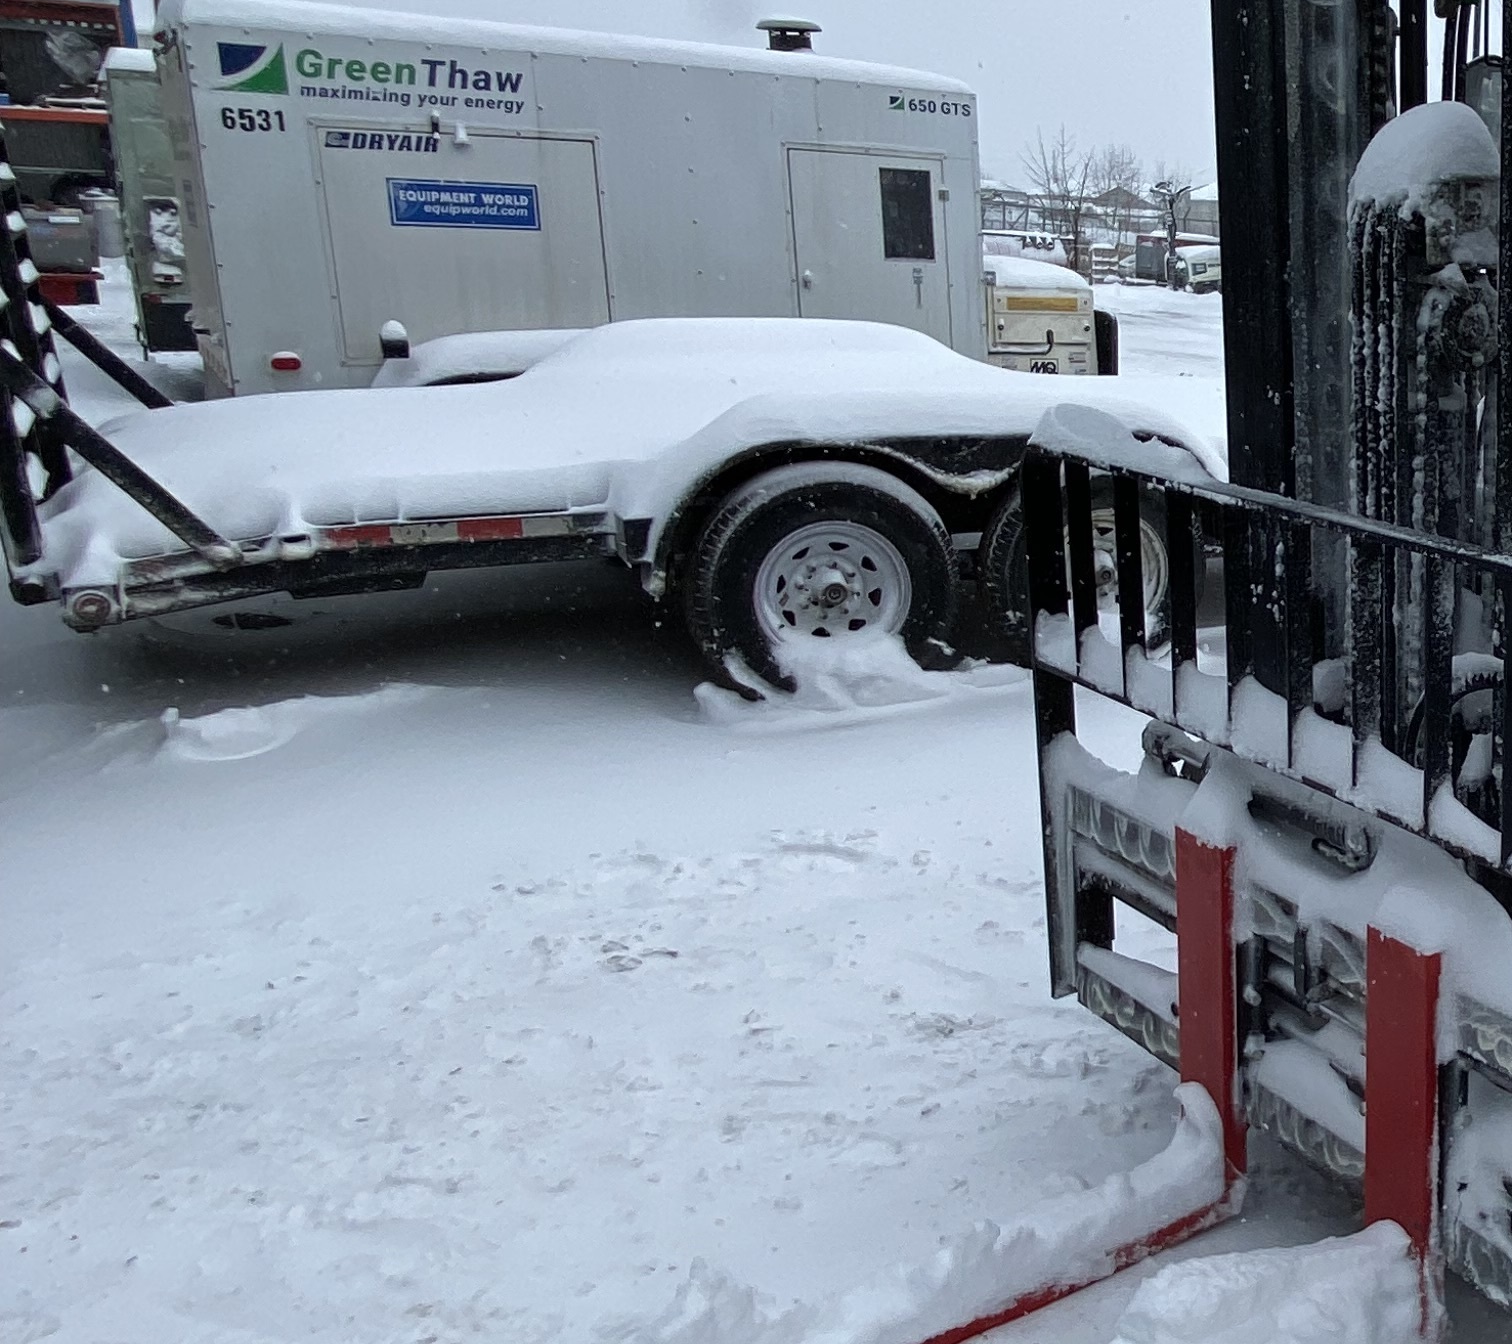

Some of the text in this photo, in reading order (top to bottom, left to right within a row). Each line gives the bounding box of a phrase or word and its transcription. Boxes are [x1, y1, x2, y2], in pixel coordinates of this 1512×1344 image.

[300, 85, 525, 114] maximizing your energy
[908, 98, 971, 117] 650 GTS
[221, 107, 286, 132] 6531
[351, 132, 439, 153] DRYAIR
[399, 189, 529, 206] EQUIPMENT WORLD
[423, 203, 529, 217] equipworld.com
[1030, 361, 1059, 374] MQ
